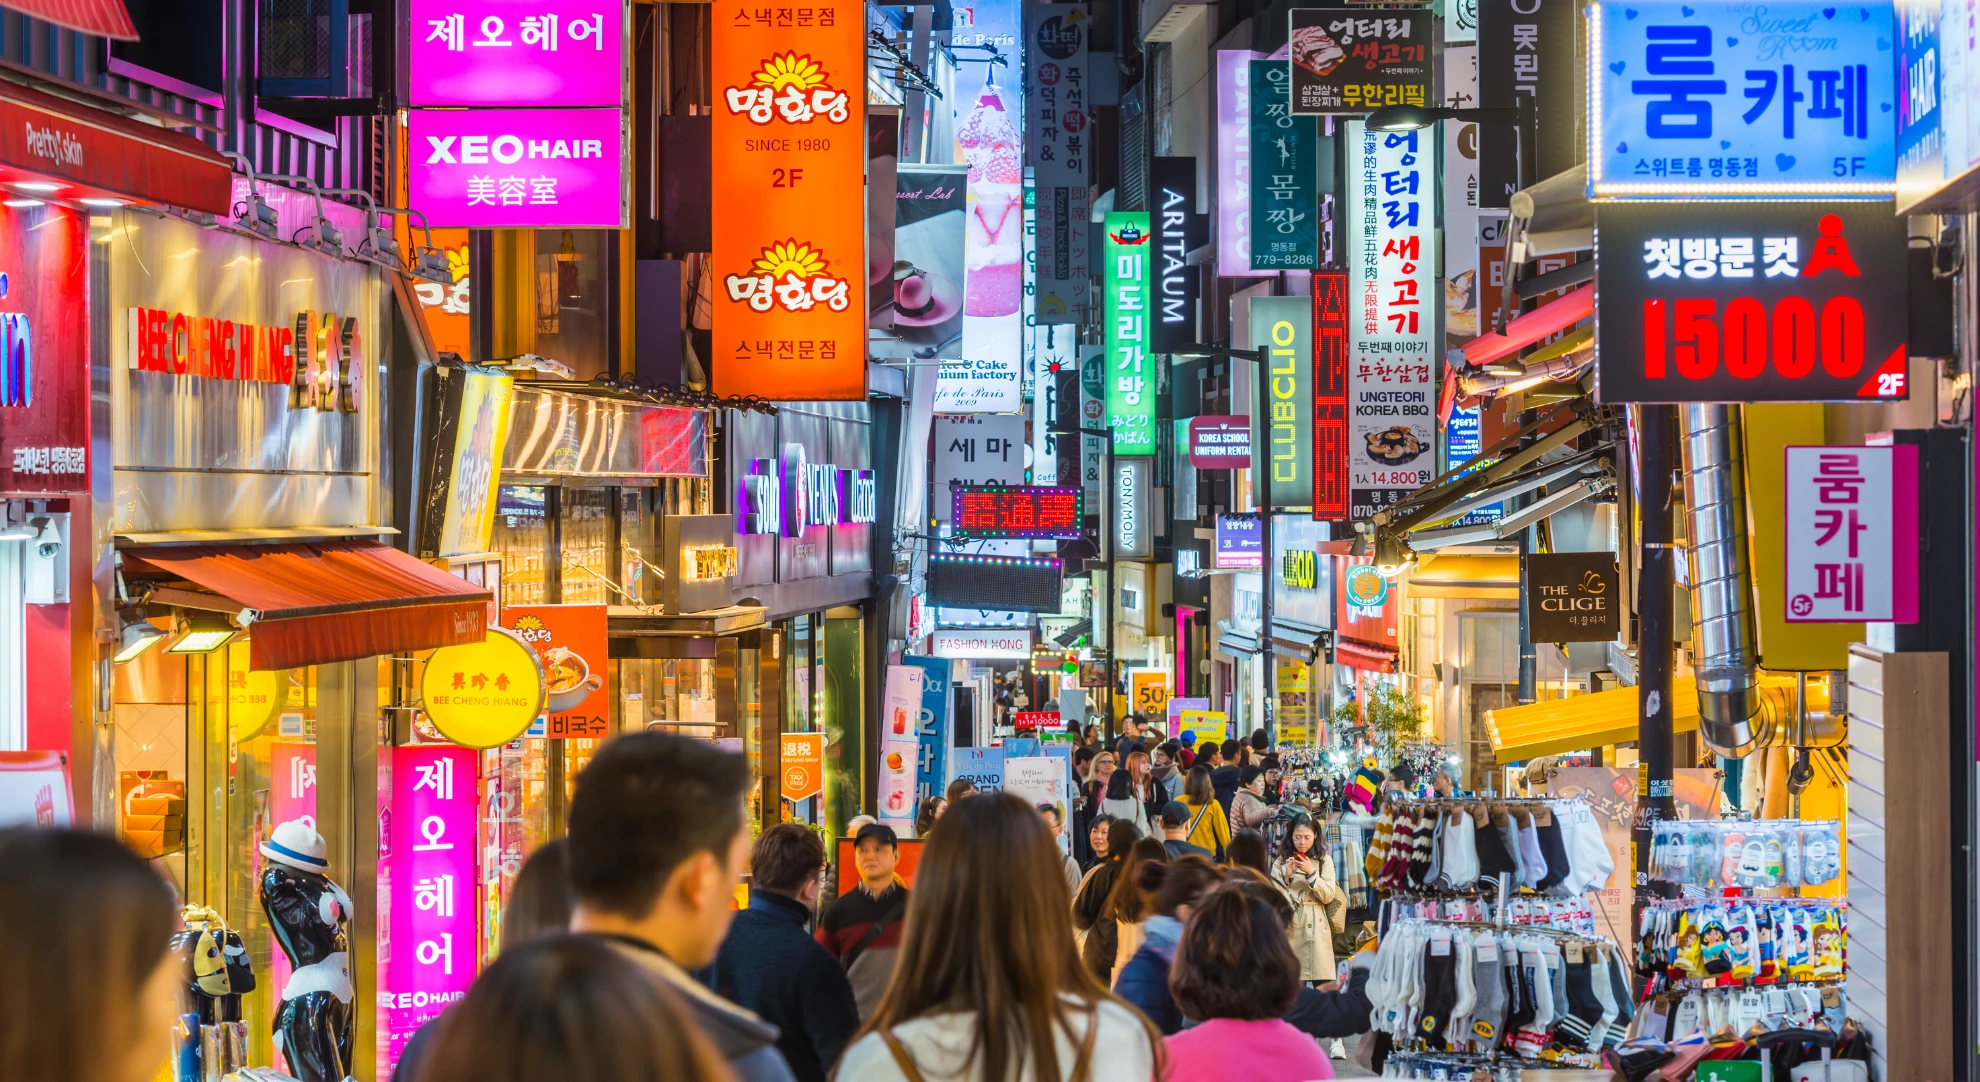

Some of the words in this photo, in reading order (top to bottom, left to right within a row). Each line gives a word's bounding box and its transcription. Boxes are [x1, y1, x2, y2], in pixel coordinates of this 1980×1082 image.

[734, 7, 835, 28] 스낵전문점
[425, 13, 604, 51] 제오헤어
[1329, 18, 1411, 45] 엉터리
[1351, 41, 1425, 70] 생고기
[1301, 96, 1341, 107] 된장찌개
[1343, 83, 1425, 108] 무한리필
[725, 87, 850, 125] 명화당
[62, 131, 83, 167] skin
[426, 135, 524, 165] XEO
[527, 140, 603, 159] HAIR
[745, 139, 791, 152] SINCE
[795, 138, 831, 152] 1980
[1634, 157, 1703, 177] 스위트룸
[1709, 157, 1759, 177] 명동점
[1832, 157, 1866, 177] 5F
[772, 168, 804, 188] 2F
[467, 174, 559, 206] 美容室
[925, 186, 956, 200] Lab
[1162, 187, 1185, 324] ARITAUM
[1255, 255, 1314, 265] 779-8286
[1643, 237, 1755, 279] 첫방문
[1762, 236, 1799, 279] 컷
[726, 273, 851, 313] 명화당
[1116, 254, 1145, 406] 미도리가방
[1643, 296, 1865, 380] 15000
[137, 306, 169, 373] BEE
[171, 312, 236, 381] CHENG
[239, 323, 294, 386] HIANG
[735, 339, 836, 361] 스낵전문점
[1357, 342, 1392, 354] 두번째
[1394, 341, 1428, 354] 이야기
[975, 359, 1008, 370] Cake
[1356, 361, 1430, 385] 무한삼겹
[970, 370, 1017, 381] factory
[1877, 373, 1905, 395] 2F
[970, 386, 1006, 398] Paris
[1360, 391, 1426, 403] UNGTEORI
[1112, 414, 1149, 428] みどり
[1356, 405, 1400, 416] KOREA
[1402, 405, 1430, 417] BBQ
[1114, 431, 1150, 444] かばん
[1198, 433, 1222, 443] KOREA
[1222, 433, 1250, 443] SCHOOL
[948, 438, 1012, 462] 세마
[1195, 445, 1227, 456] UNIFORM
[1036, 474, 1057, 482] Coff
[806, 463, 839, 526] VENUS
[1121, 467, 1133, 550] TONYMOLY
[1539, 585, 1568, 596] THE
[1541, 597, 1606, 612] CLIGE
[940, 639, 988, 650] FASHION
[991, 639, 1024, 650] HONG
[433, 696, 450, 705] BEE
[452, 696, 491, 706] CHENG
[493, 697, 528, 707] HIANG
[1140, 687, 1165, 704] 50
[552, 715, 606, 735] 비국수
[1183, 715, 1196, 723] nail
[1205, 716, 1223, 724] heart
[783, 742, 812, 756] 退税
[412, 756, 454, 976] 제오헤어
